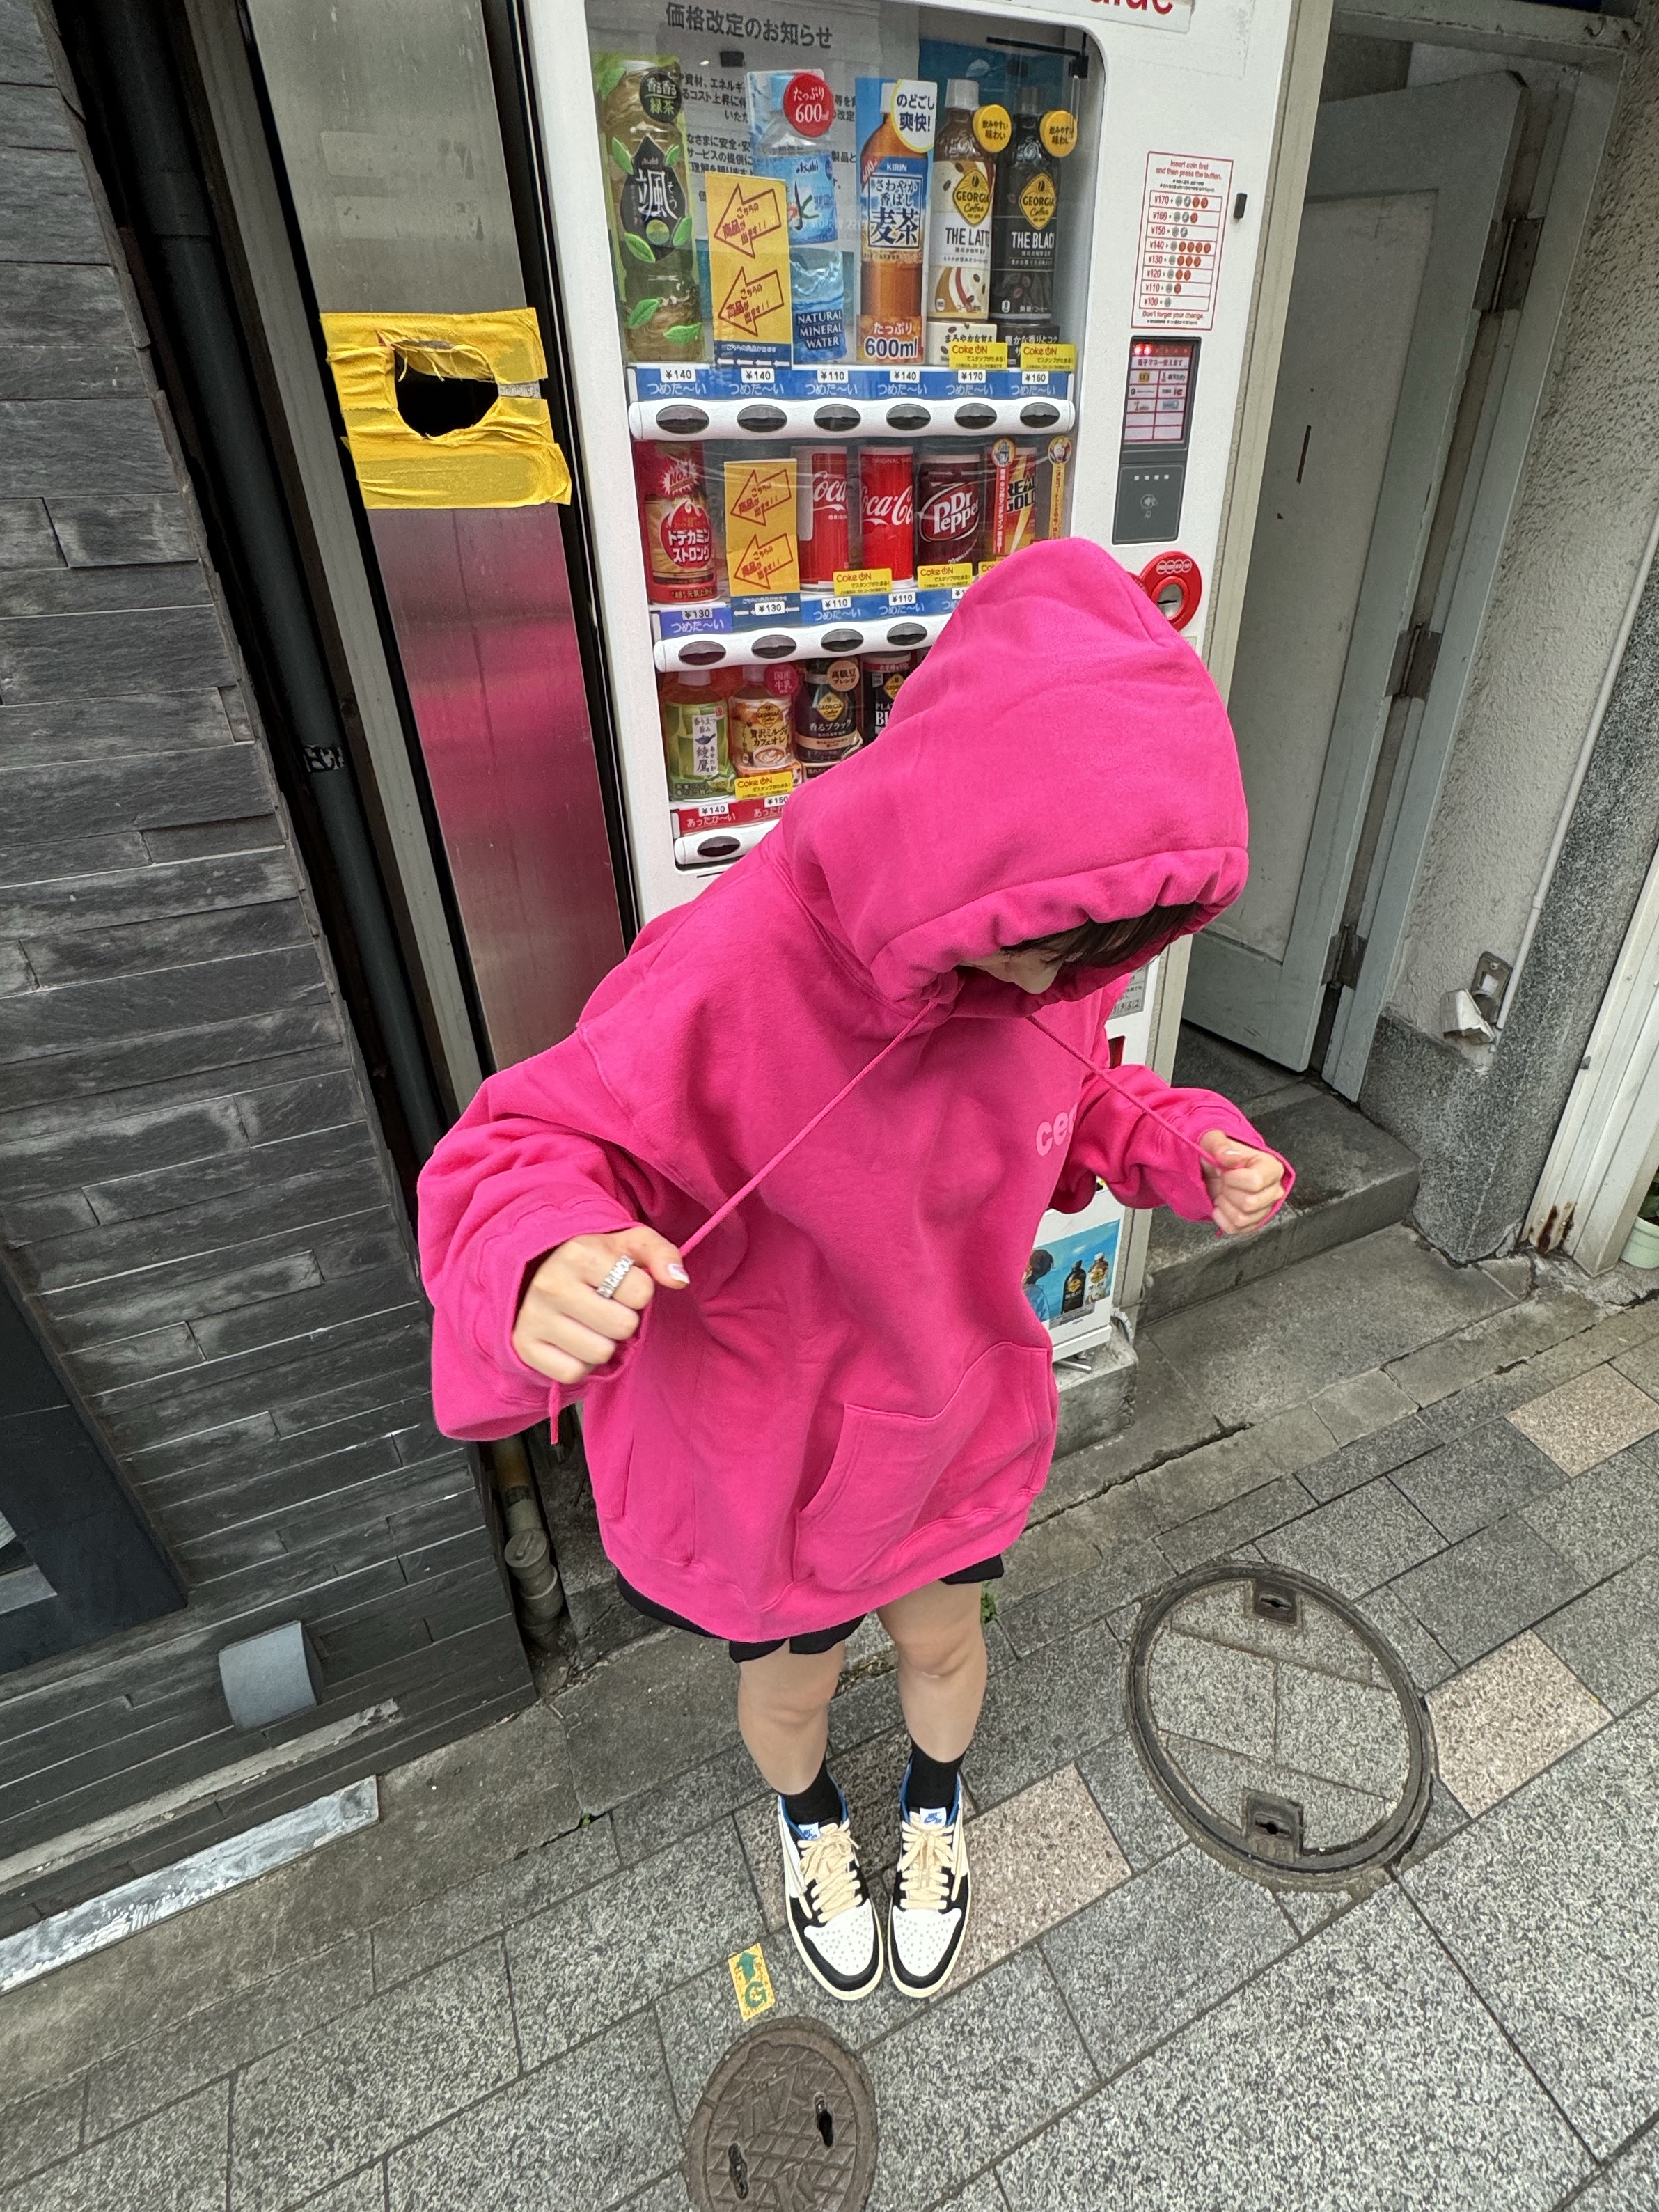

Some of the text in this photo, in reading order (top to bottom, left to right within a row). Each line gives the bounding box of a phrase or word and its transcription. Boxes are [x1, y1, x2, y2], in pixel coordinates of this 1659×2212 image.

[666, 2, 833, 49] 価格改定のお知らせ
[793, 86, 824, 102] たっぷり
[649, 98, 675, 115] 緑茶
[897, 94, 935, 111] のどこし
[899, 112, 931, 132] 爽快!
[982, 120, 1009, 130] 飲みやすい
[985, 130, 1006, 140] 味わい
[886, 163, 908, 172] KIRIN
[1170, 159, 1186, 168] Insert
[876, 179, 917, 195] さわやか
[881, 192, 913, 207] 香ばし
[870, 207, 919, 245] 麦茶
[945, 227, 966, 245] THE
[1012, 232, 1055, 249] THE BLAC
[797, 311, 842, 324] NATURAL
[800, 323, 842, 336] MINERAL
[874, 322, 912, 335] たっぷり
[806, 336, 839, 349] WATER
[865, 337, 918, 358] 600ml
[952, 345, 973, 354] Coke
[1023, 346, 1044, 356] Coke
[665, 370, 692, 380] ¥140
[746, 370, 771, 380] ¥140
[821, 371, 844, 381] ¥110
[894, 371, 916, 381] ¥140
[961, 372, 983, 381] ¥170
[1025, 373, 1046, 382] ¥160
[951, 491, 973, 514] Dr
[668, 528, 709, 546] ドデカミン
[673, 545, 710, 563] ストロング
[920, 567, 940, 576] Coke
[836, 574, 858, 583] Coke
[825, 599, 848, 608] ¥110
[892, 594, 913, 604] ¥110
[759, 604, 782, 613] ¥130
[876, 703, 893, 711] PLA
[876, 711, 890, 725] BL
[810, 719, 851, 732] 香るブラック
[753, 736, 785, 747] カフェオレ
[696, 746, 710, 773] 綾鷹
[737, 779, 758, 789] Coke
[702, 806, 725, 815] ¥140
[744, 1980, 767, 2008] G
